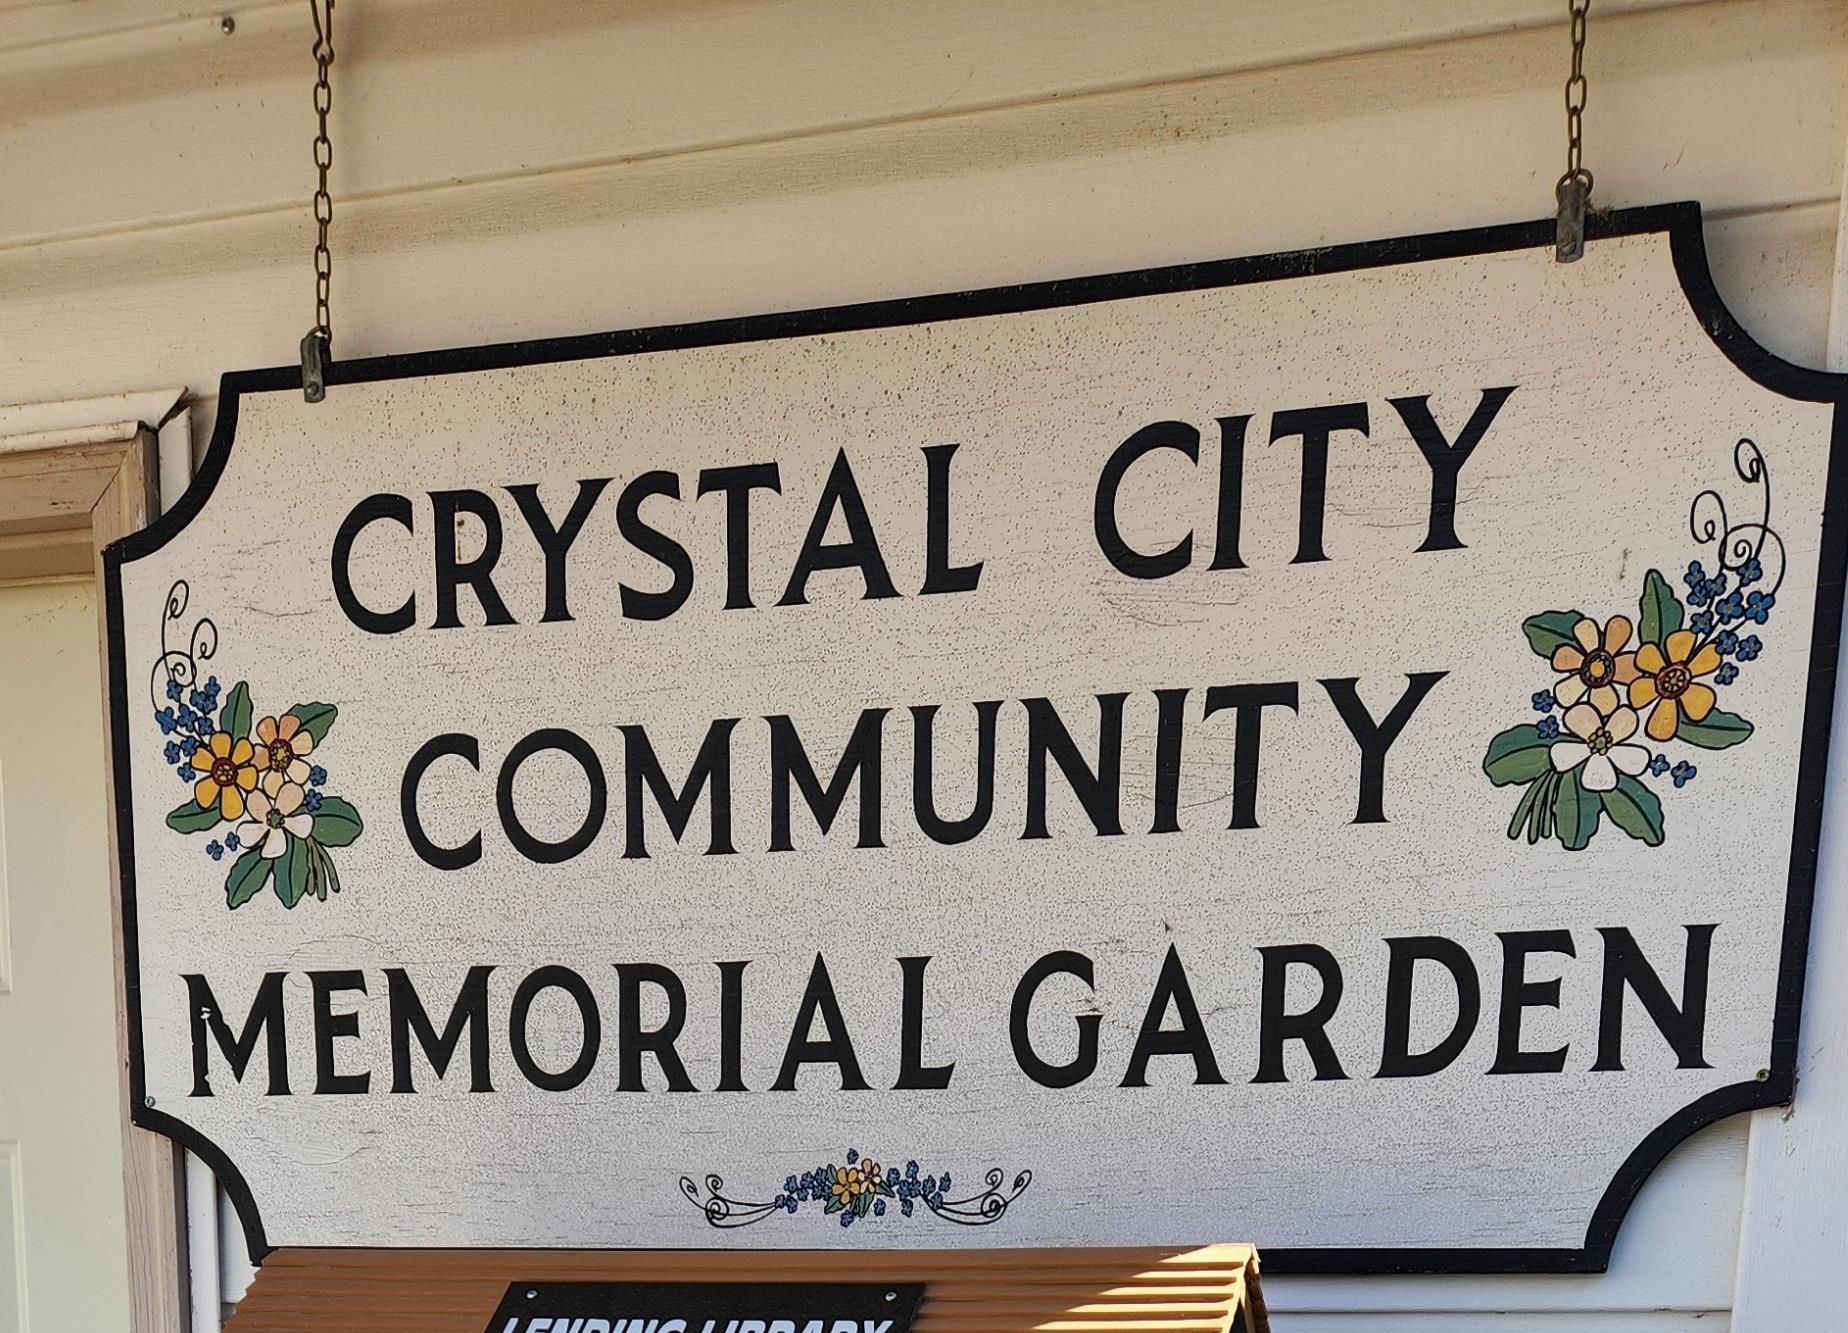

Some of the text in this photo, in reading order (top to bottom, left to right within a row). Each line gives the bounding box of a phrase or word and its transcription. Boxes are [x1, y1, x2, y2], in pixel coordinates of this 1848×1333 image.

[331, 386, 1519, 634] CRYSTAL CITY
[401, 671, 1450, 870] COMMUNITY
[180, 921, 1718, 1097] MEMORIAL GARDEN
